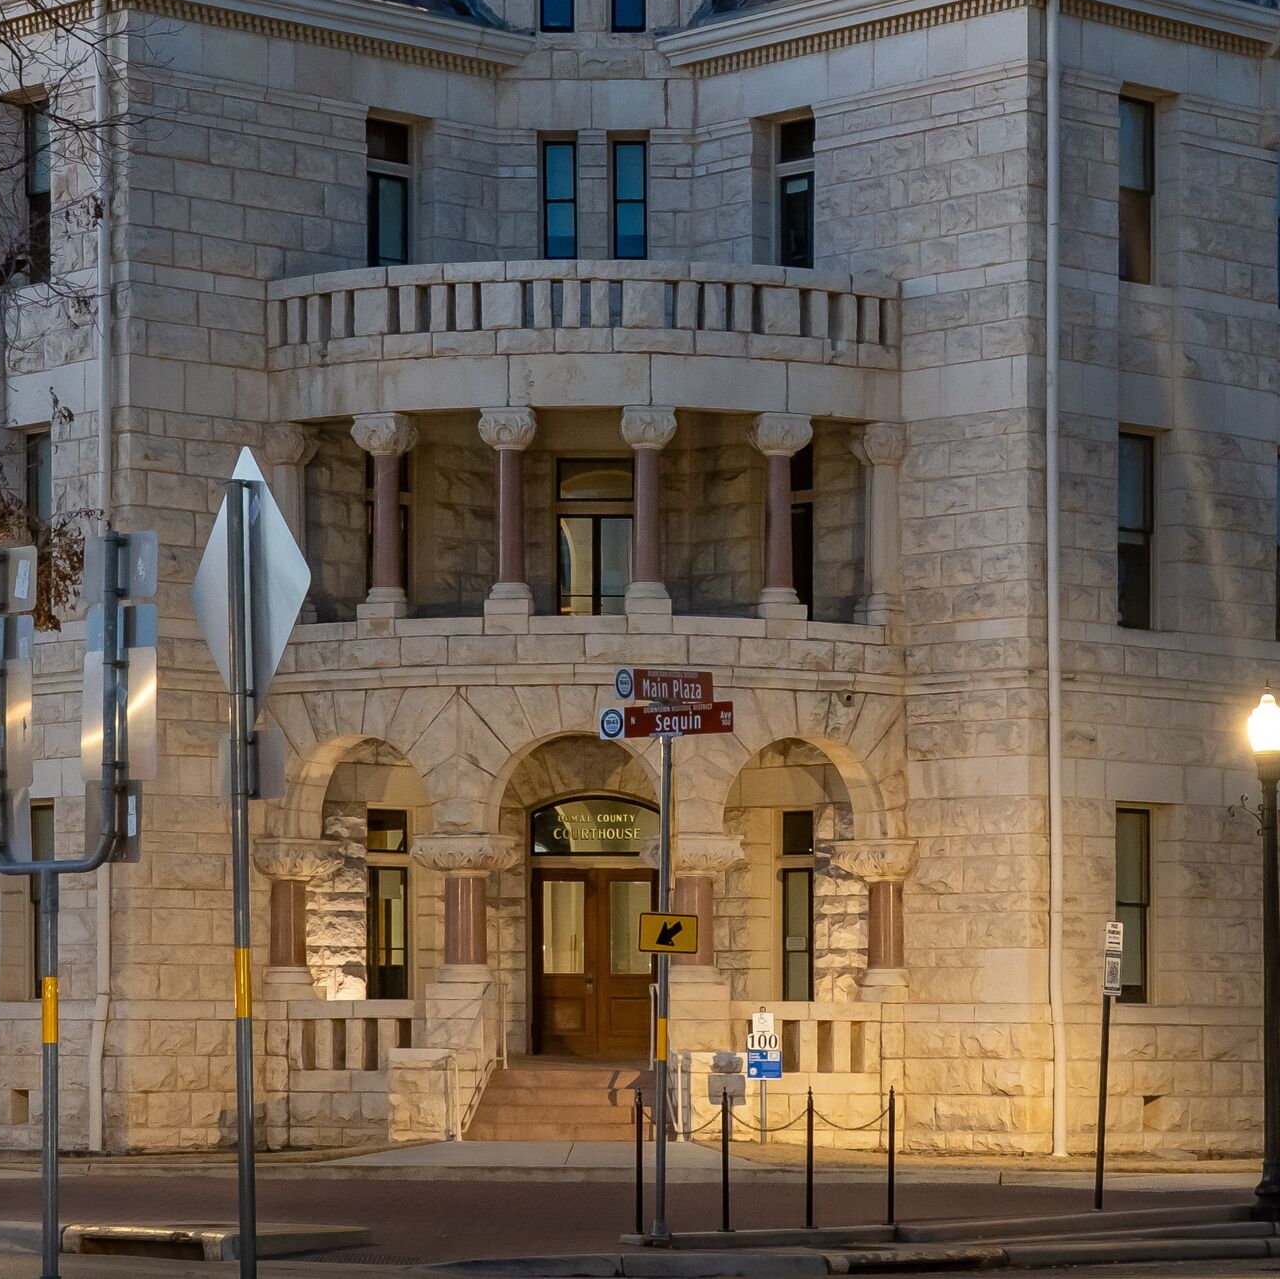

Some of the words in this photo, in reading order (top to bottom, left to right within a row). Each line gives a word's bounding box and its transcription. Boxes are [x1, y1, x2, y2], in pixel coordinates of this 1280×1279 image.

[642, 677, 669, 699] Main
[673, 678, 702, 699] Plaza
[630, 716, 636, 725] N
[720, 710, 732, 719] Ave
[597, 814, 636, 823] COUNTY
[553, 828, 641, 840] COURTHOUSE
[749, 1034, 778, 1049] 100
